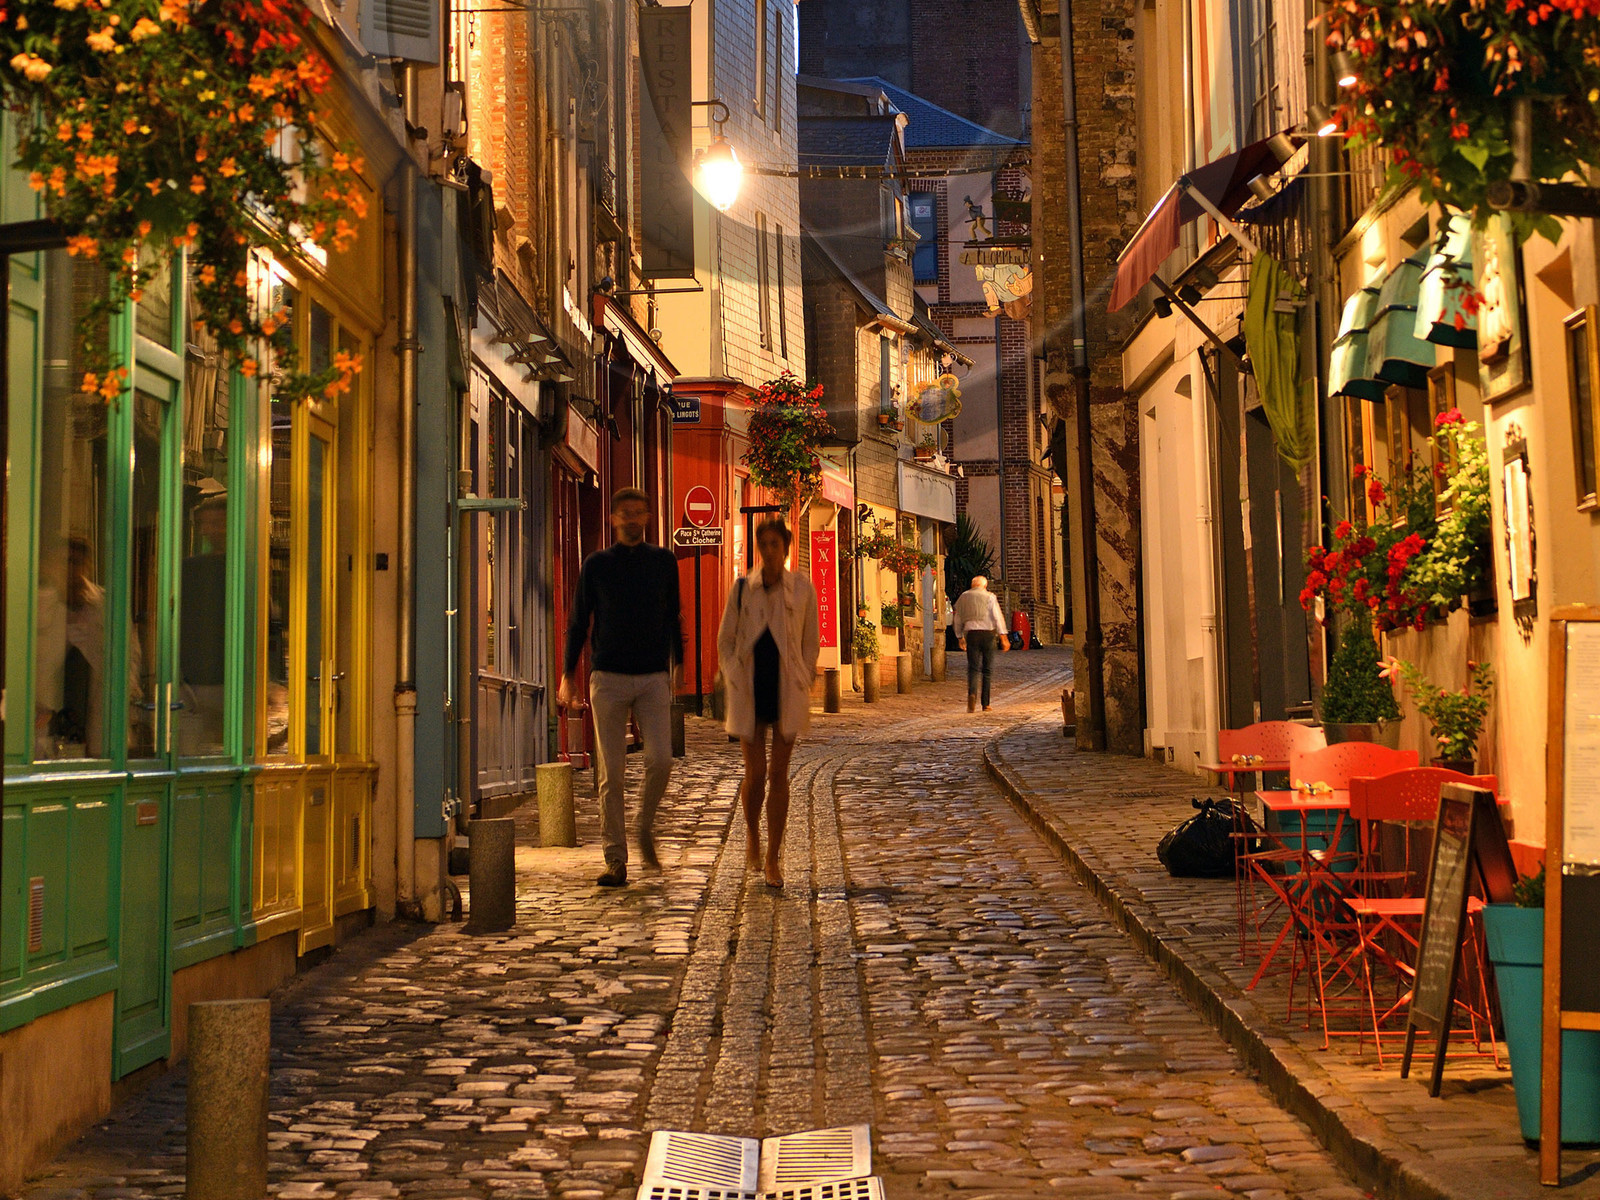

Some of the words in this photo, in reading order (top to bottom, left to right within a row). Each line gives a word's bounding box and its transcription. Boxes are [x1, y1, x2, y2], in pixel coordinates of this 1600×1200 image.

[656, 19, 680, 268] RESTAURANT
[676, 410, 699, 419] LINGOTS
[700, 529, 721, 538] Catherine
[692, 536, 716, 544] Clocher
[820, 568, 829, 628] Vicomte
